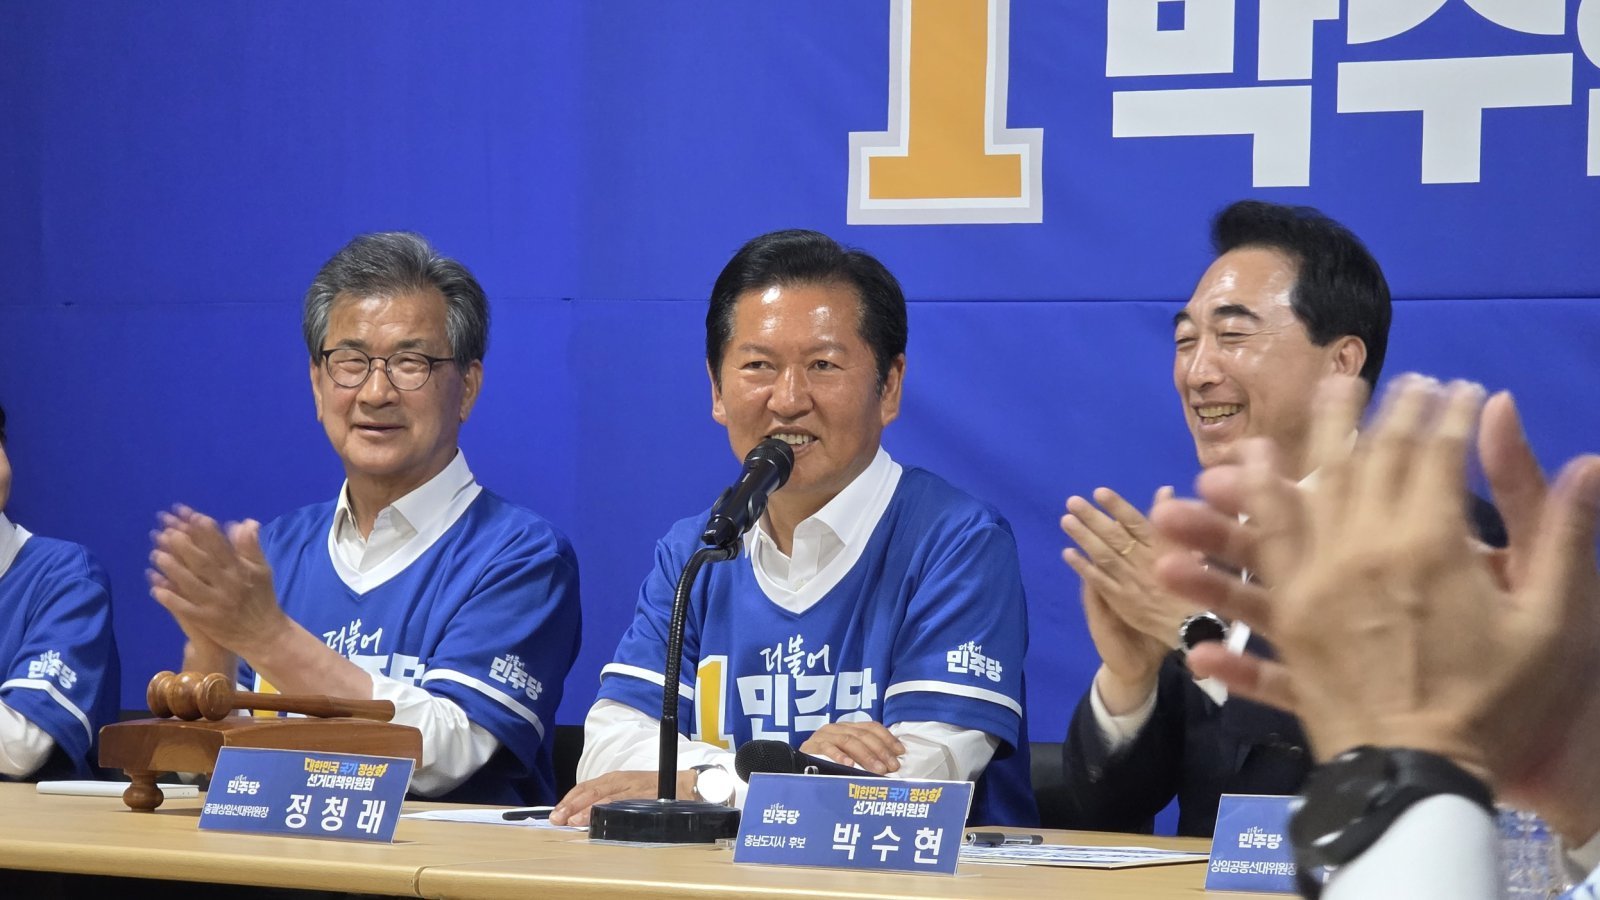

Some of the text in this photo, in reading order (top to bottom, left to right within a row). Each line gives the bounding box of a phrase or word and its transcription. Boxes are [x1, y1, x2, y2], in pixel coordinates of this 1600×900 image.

[1105, 0, 1600, 188] 박수
[322, 618, 383, 656] 더불어
[759, 633, 831, 679] 더불어
[946, 650, 1003, 682] 민주당
[27, 658, 78, 690] 민주당
[488, 656, 543, 701] 민주당
[690, 654, 735, 754] 1
[304, 757, 389, 777] 대한민국 국가 정상화
[226, 780, 261, 795] 민주당
[306, 773, 375, 791] 선거대책위원회
[848, 783, 943, 803] 대한민국 국가 정상화
[203, 802, 270, 818] 총괄상임선대위원장
[762, 809, 801, 825] 민주당
[852, 800, 930, 819] 선거대책위원회
[744, 834, 807, 849] 충남도지사 후보
[1238, 832, 1283, 850] 민주당
